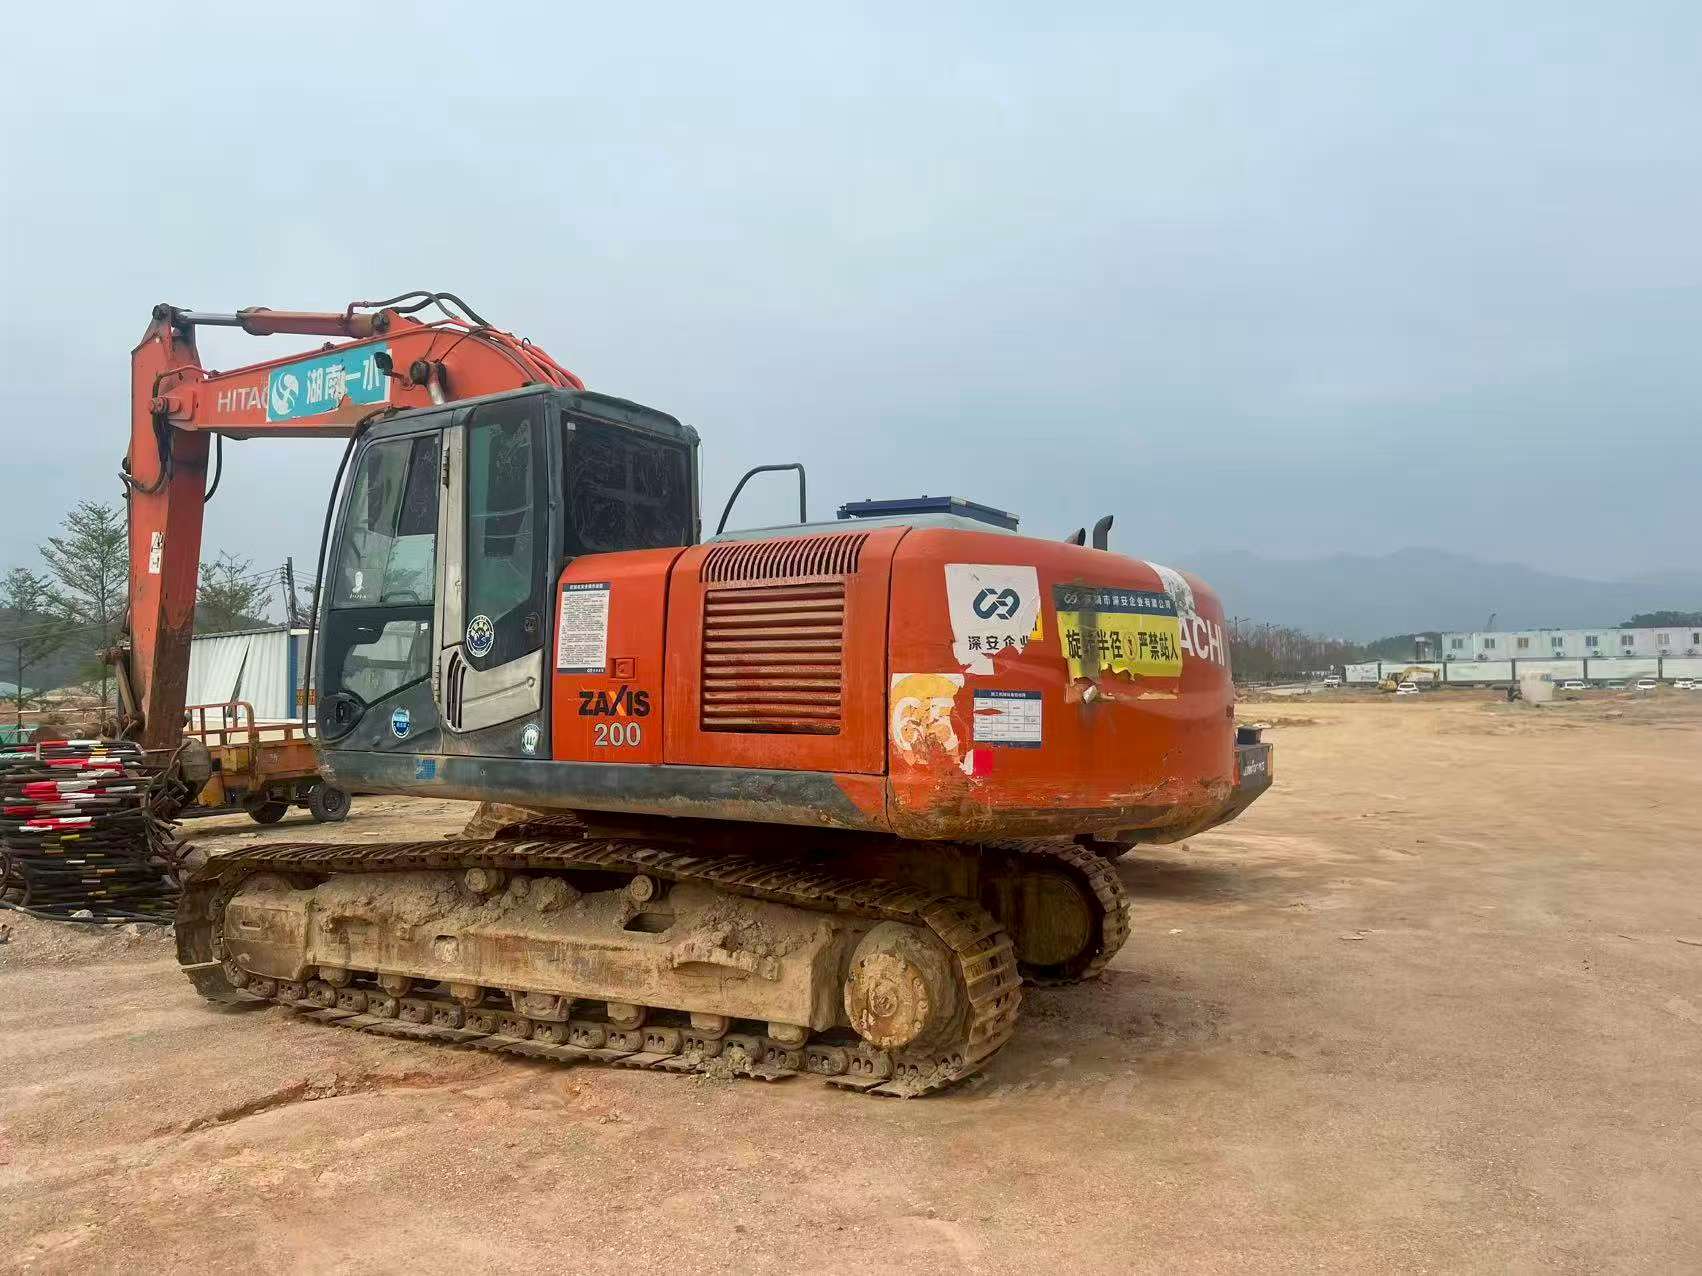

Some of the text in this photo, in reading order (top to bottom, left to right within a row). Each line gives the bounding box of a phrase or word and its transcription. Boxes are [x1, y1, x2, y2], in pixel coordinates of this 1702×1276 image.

[1065, 629, 1124, 660] 旋半径
[578, 684, 651, 717] ZAXIS
[593, 721, 641, 747] 200
